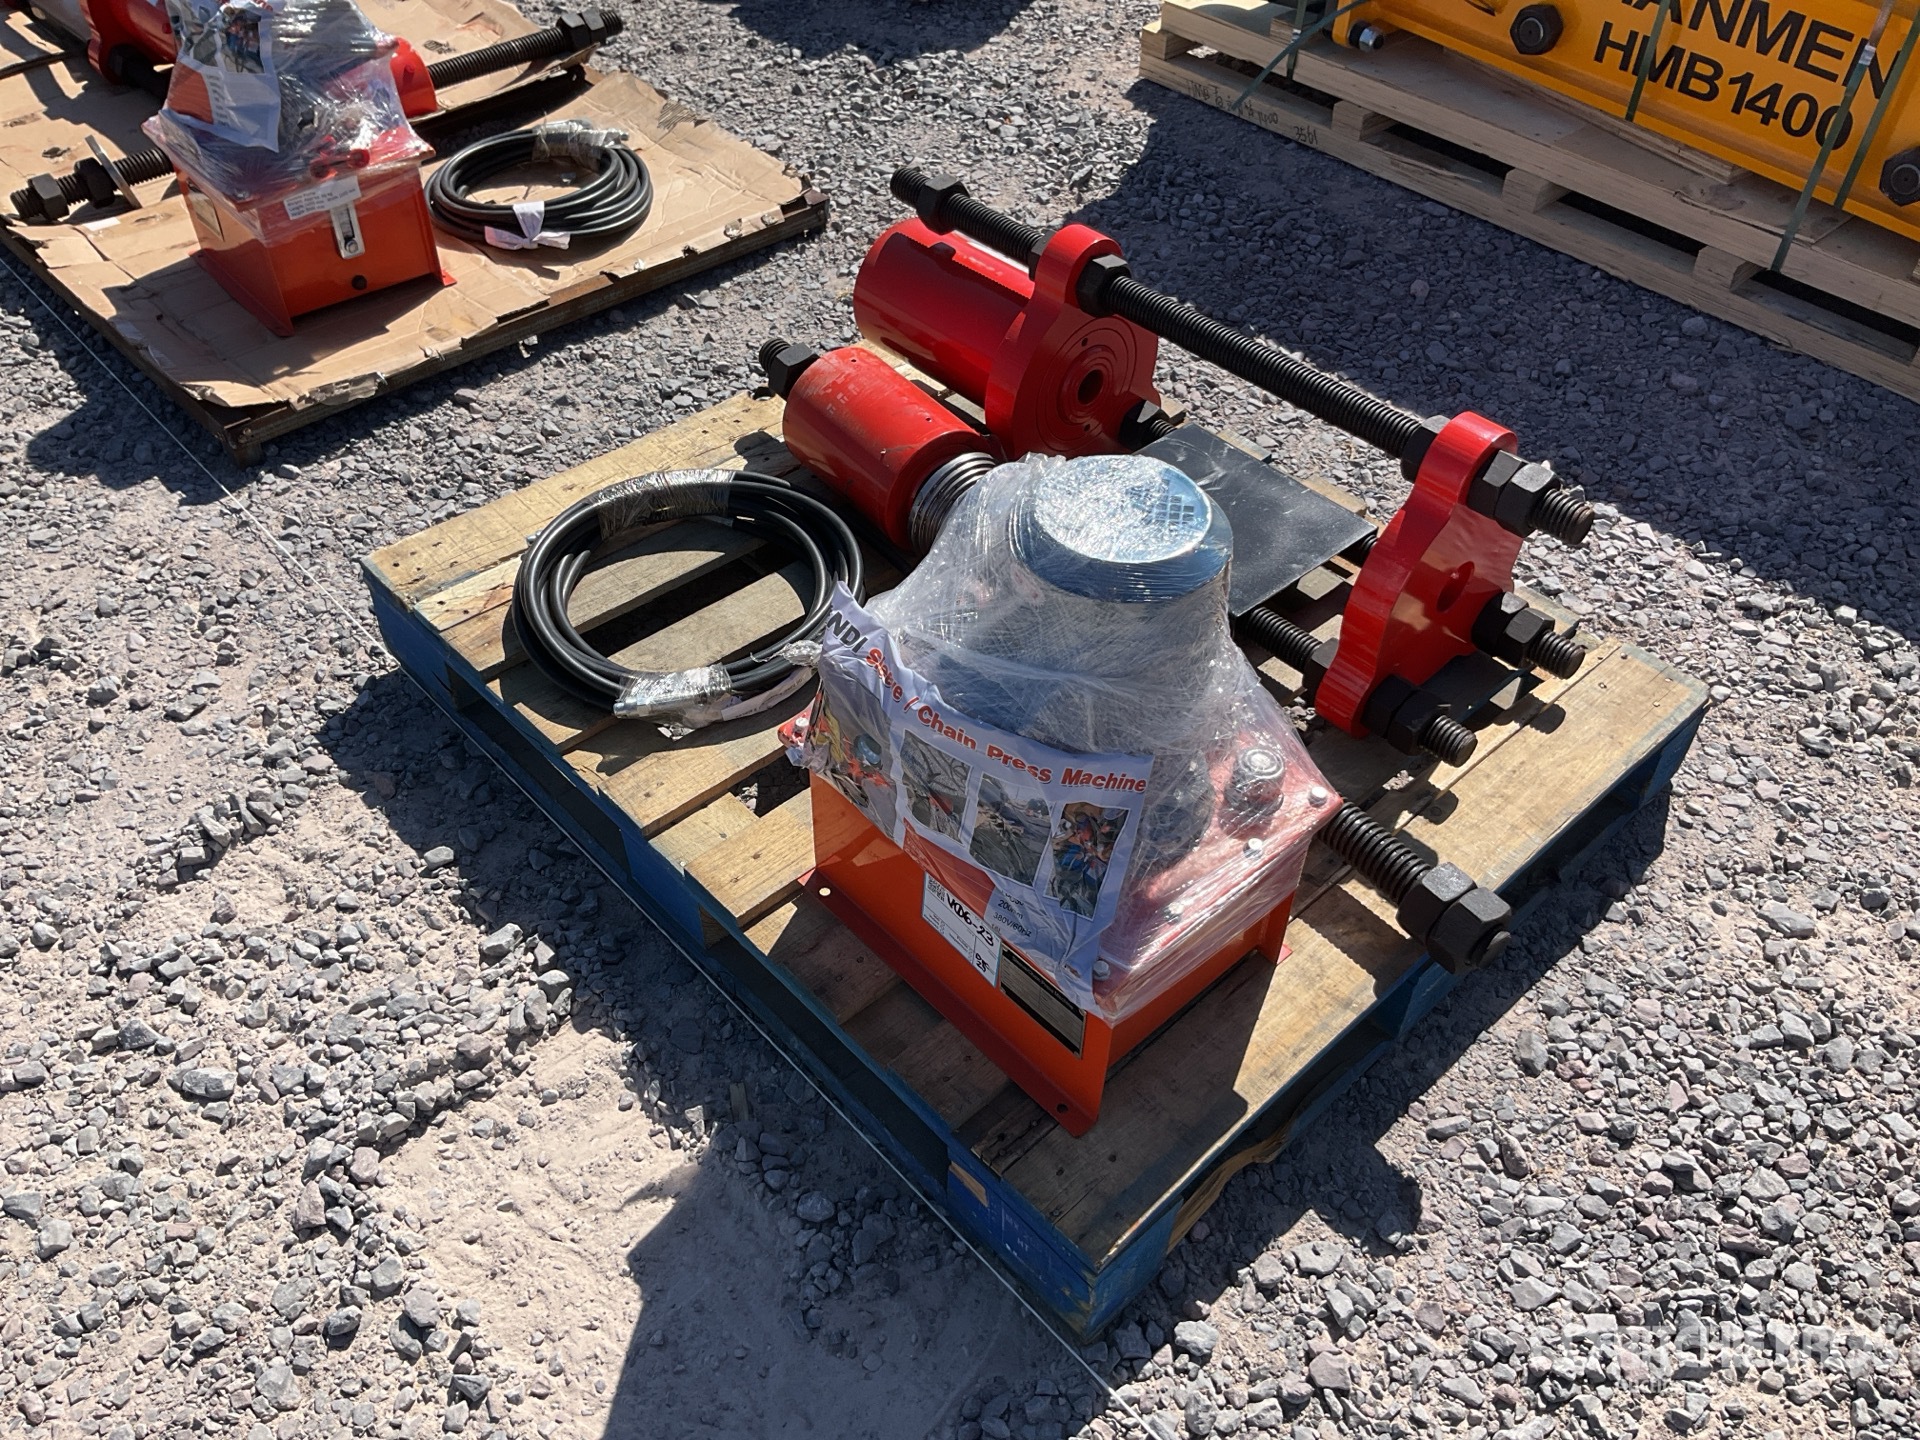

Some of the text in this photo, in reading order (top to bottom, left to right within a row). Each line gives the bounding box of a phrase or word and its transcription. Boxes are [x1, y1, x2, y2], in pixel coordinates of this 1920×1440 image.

[1594, 21, 1854, 151] HMB1400
[917, 704, 977, 750] Chain
[987, 744, 1053, 783] Press
[1061, 768, 1147, 793] Machine
